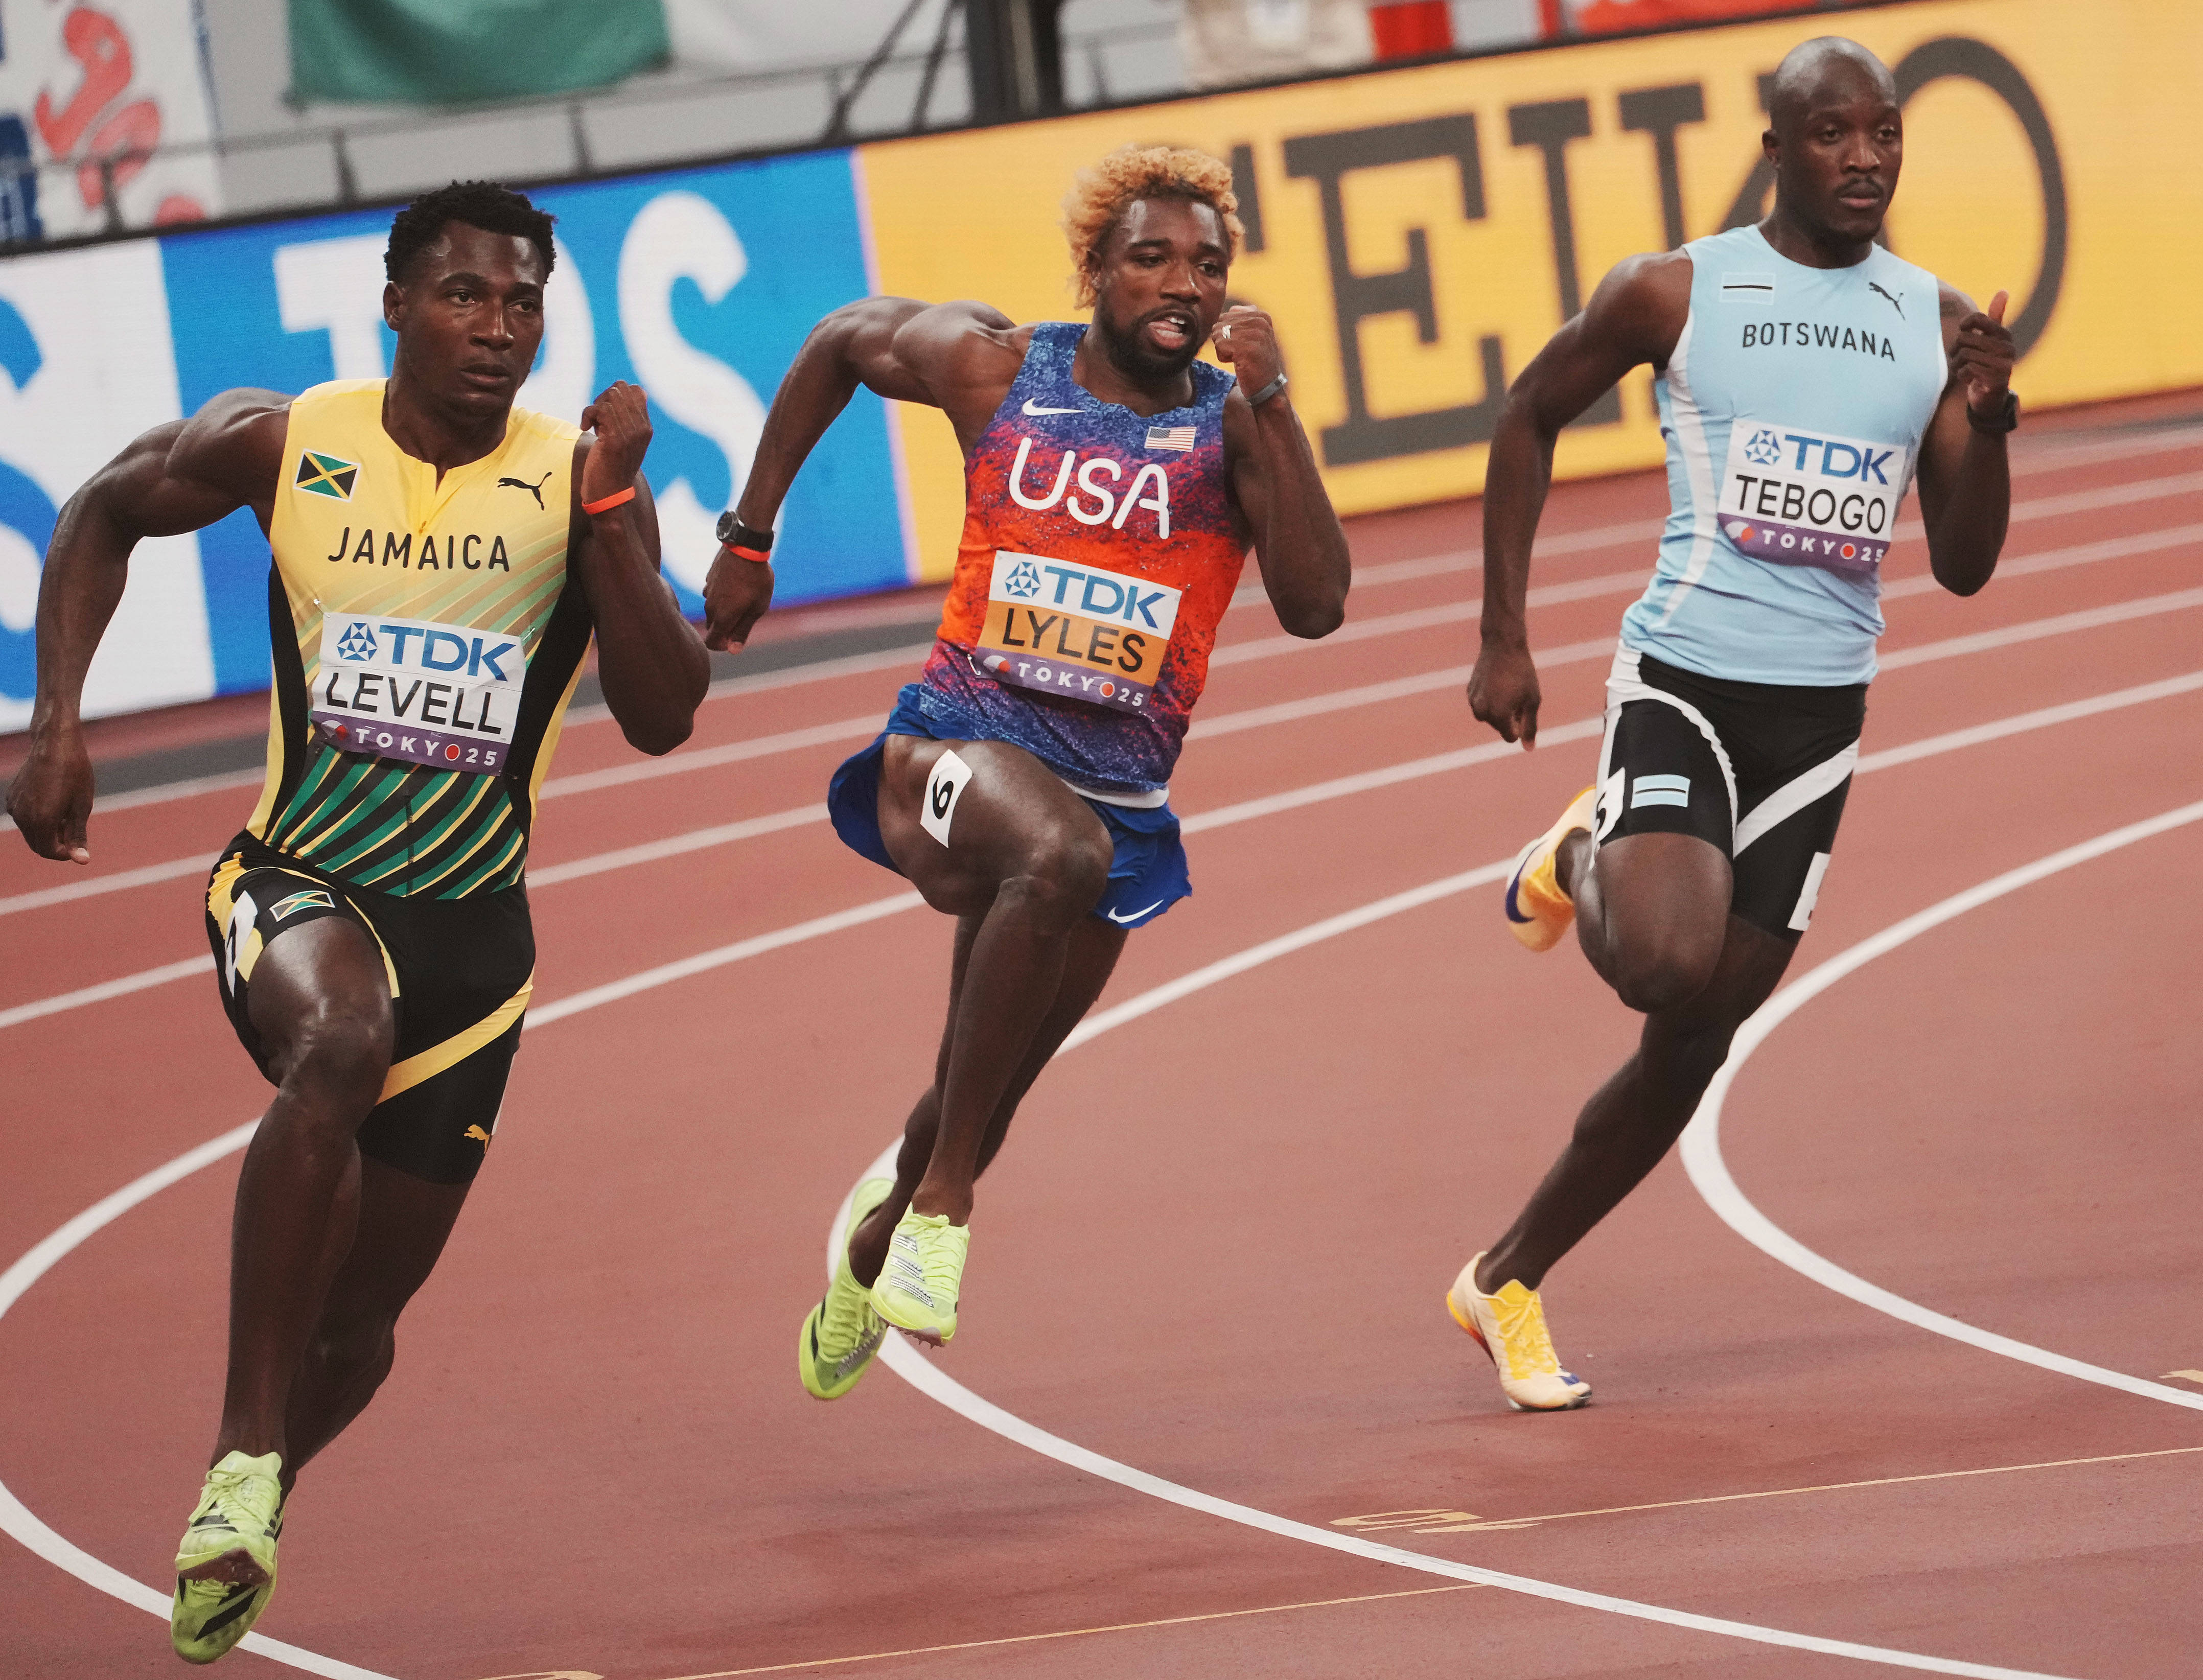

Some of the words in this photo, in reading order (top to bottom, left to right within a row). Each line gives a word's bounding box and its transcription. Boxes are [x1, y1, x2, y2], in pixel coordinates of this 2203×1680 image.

[1224, 37, 2067, 466] EIO
[1742, 322, 1895, 362] BOTSWANA
[272, 190, 783, 594] TS
[1009, 437, 1170, 540] USA
[1785, 434, 1895, 485] TDK
[1736, 474, 1886, 534] TEBOGO
[328, 527, 510, 572] JAMAICA
[1045, 566, 1166, 629] TDK
[379, 624, 517, 682] TDK
[1002, 608, 1146, 673] LYLES
[326, 672, 502, 735] LEVELL
[932, 775, 954, 820] 6
